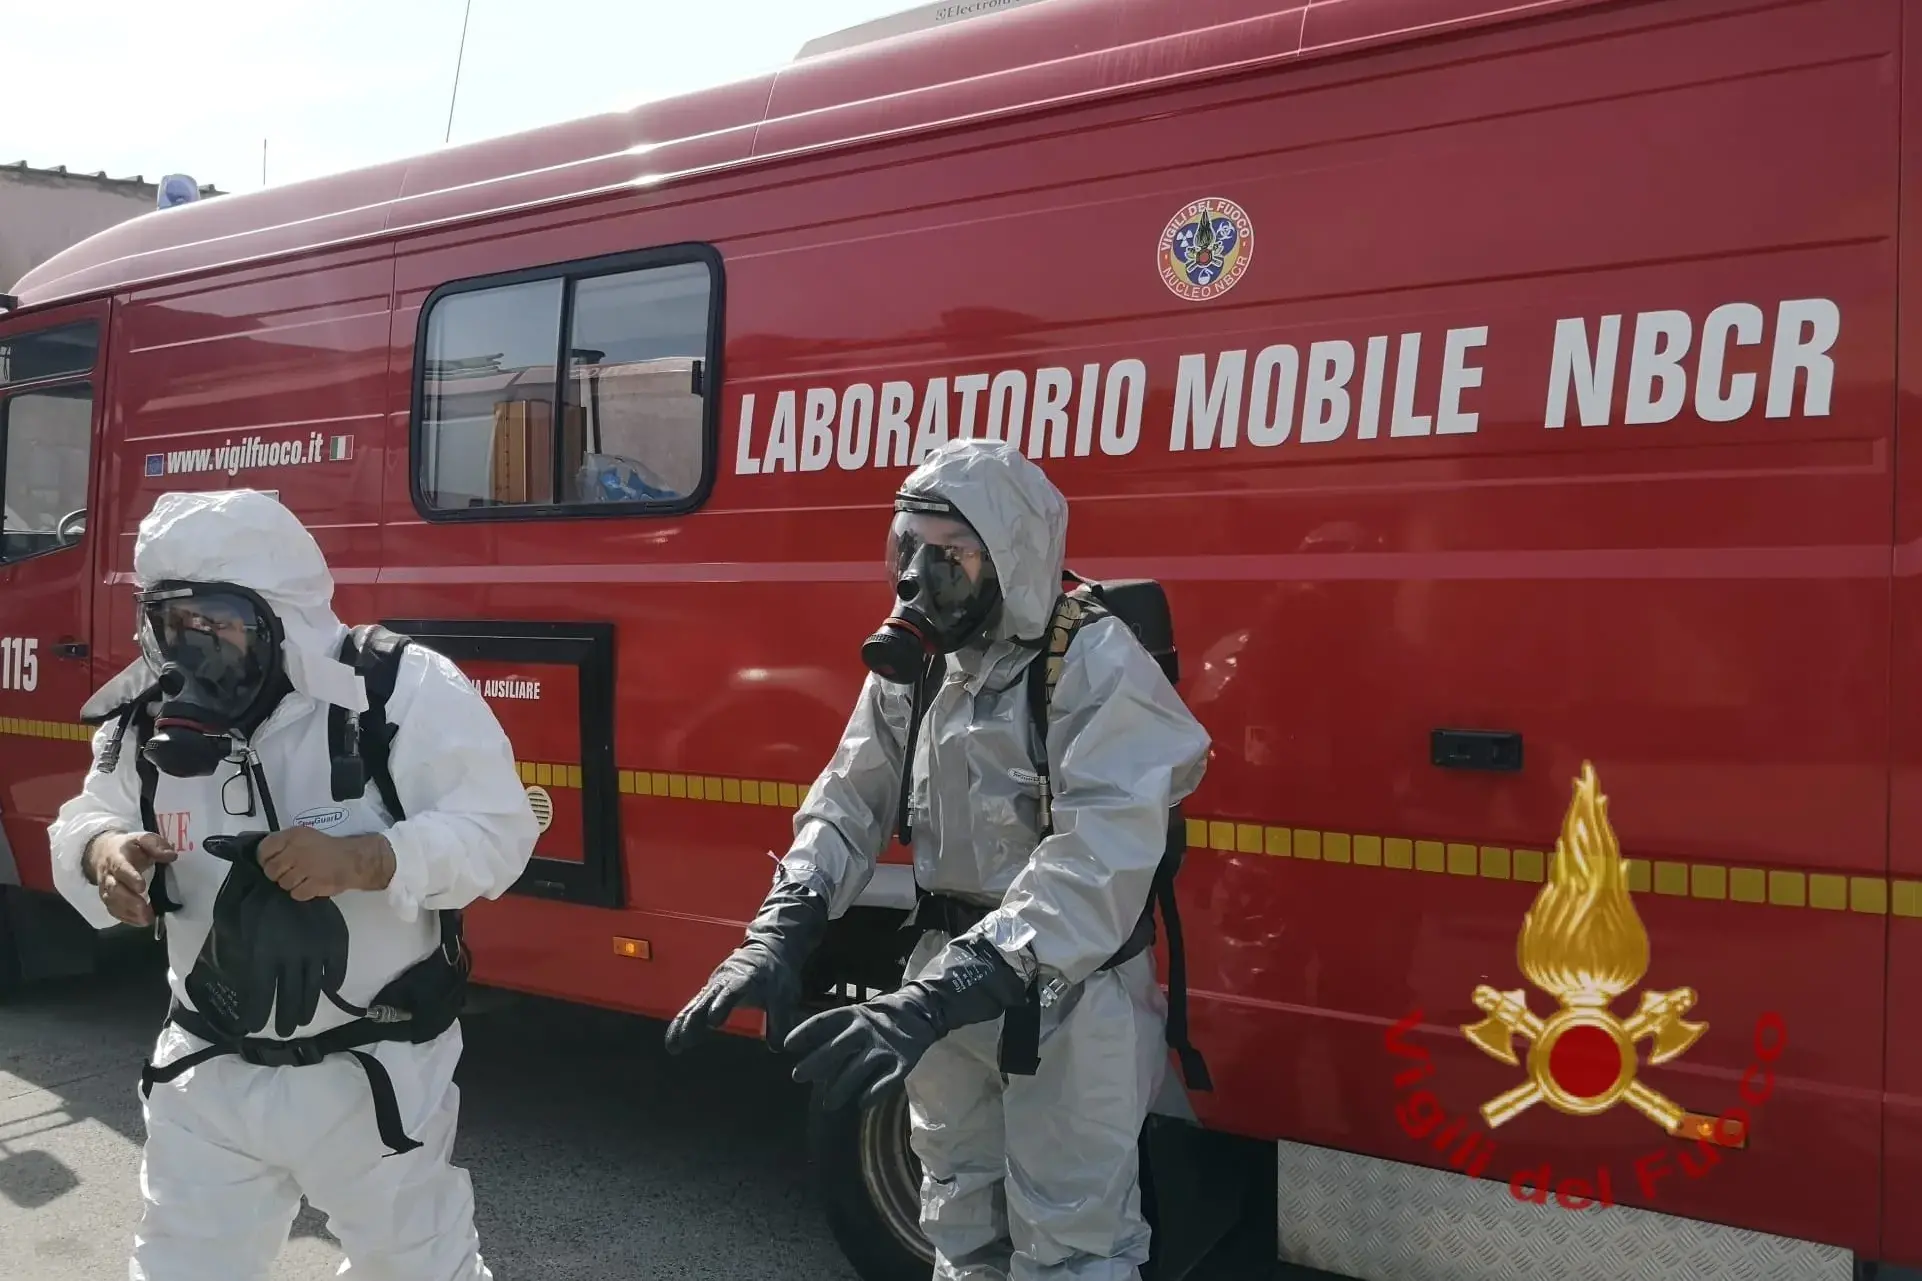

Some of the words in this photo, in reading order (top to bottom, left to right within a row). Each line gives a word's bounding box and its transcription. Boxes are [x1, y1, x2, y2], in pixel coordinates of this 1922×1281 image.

[1160, 212, 1188, 252] VIGILI
[1187, 201, 1214, 217] DEL
[1216, 200, 1250, 239] FUOCO
[1163, 266, 1211, 298] NUCLEO
[1214, 255, 1248, 293] NBCR
[735, 358, 1147, 475] LABORATORIO
[1169, 326, 1488, 452] MOBILE
[1544, 298, 1840, 429] NBCR
[167, 431, 323, 476] www.vigilfuoco.it
[1, 637, 39, 692] 115
[484, 679, 541, 700] AUSILIARE
